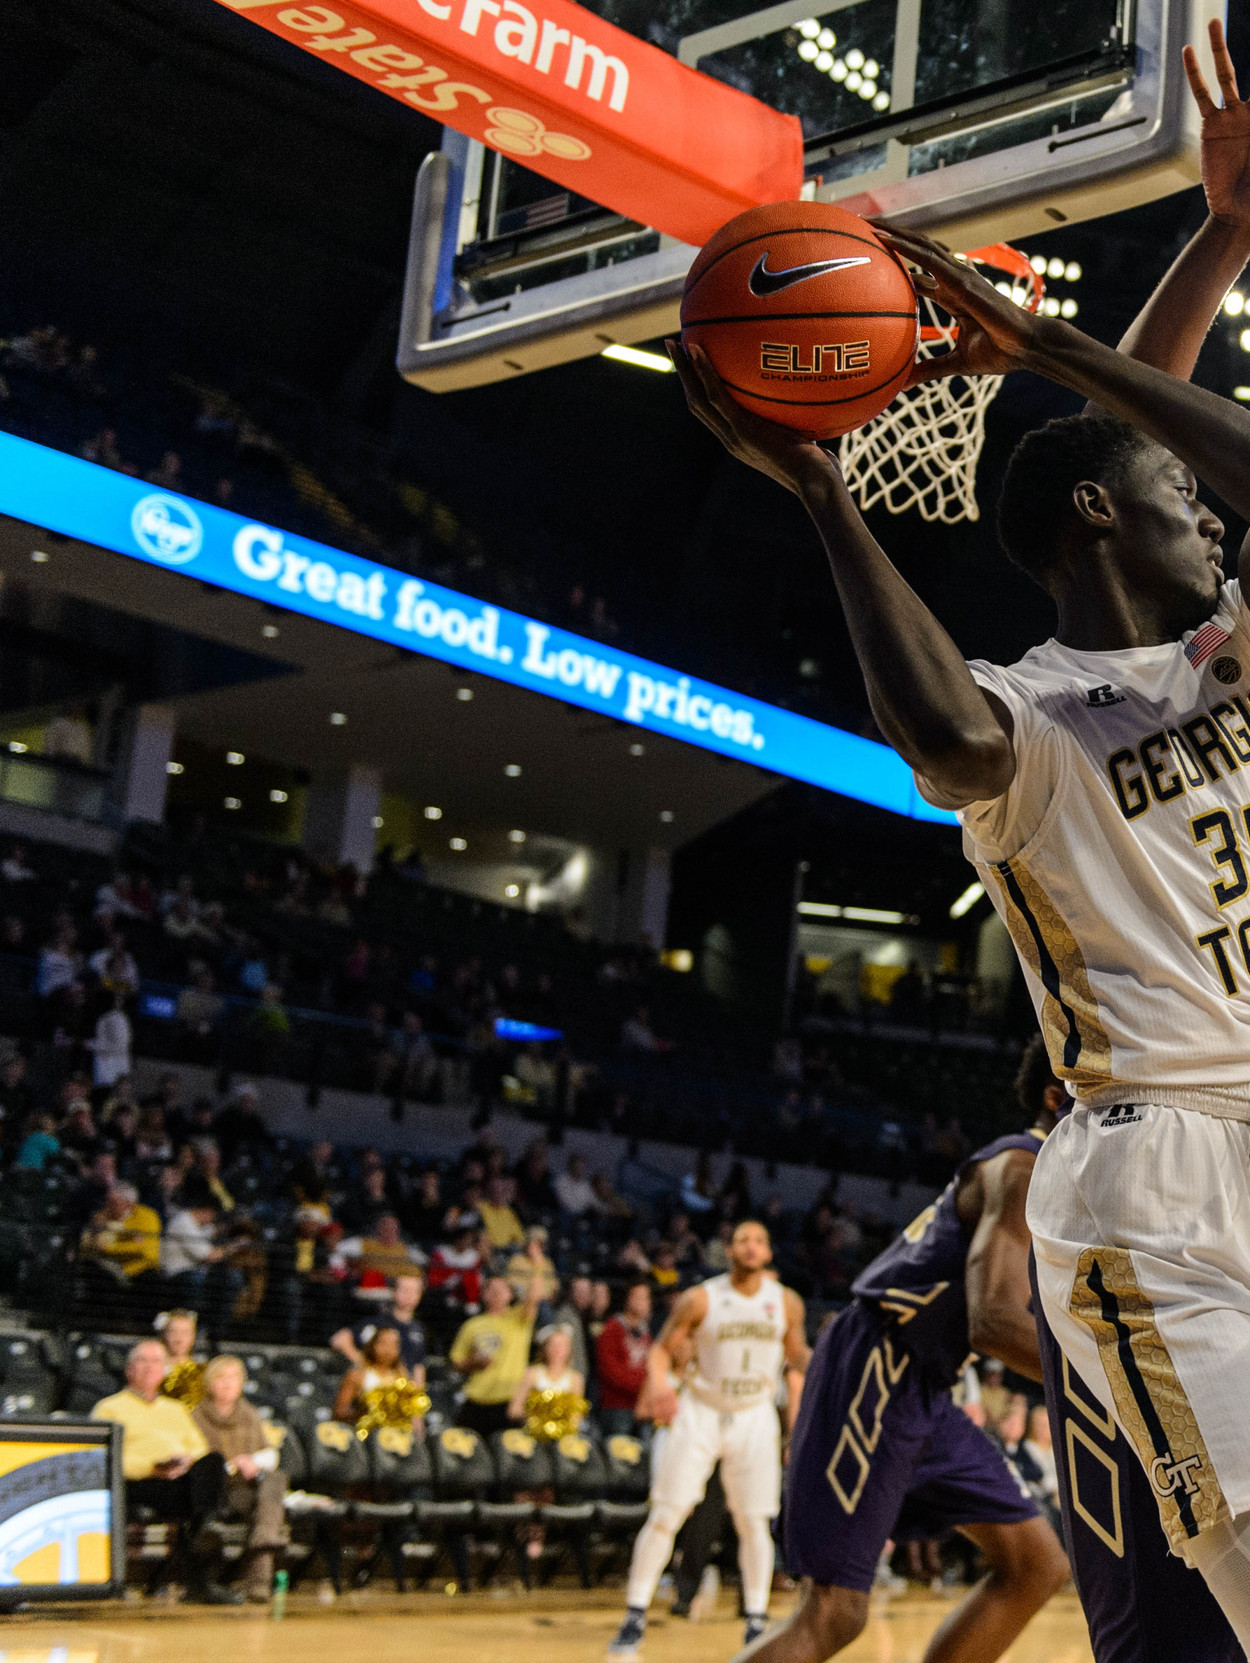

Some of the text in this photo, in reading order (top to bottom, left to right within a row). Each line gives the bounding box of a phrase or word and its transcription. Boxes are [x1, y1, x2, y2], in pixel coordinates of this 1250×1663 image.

[277, 5, 493, 111] State
[760, 340, 870, 373] ELITE
[761, 370, 870, 382] CHAMPIONSHIP
[232, 523, 387, 621] Great
[392, 579, 514, 665] food.
[521, 621, 623, 699] Low
[623, 676, 765, 751] prices.
[1087, 696, 1127, 707] RUSSELL
[1101, 1115, 1143, 1127] RUSSELL
[1151, 1452, 1202, 1497] GT
